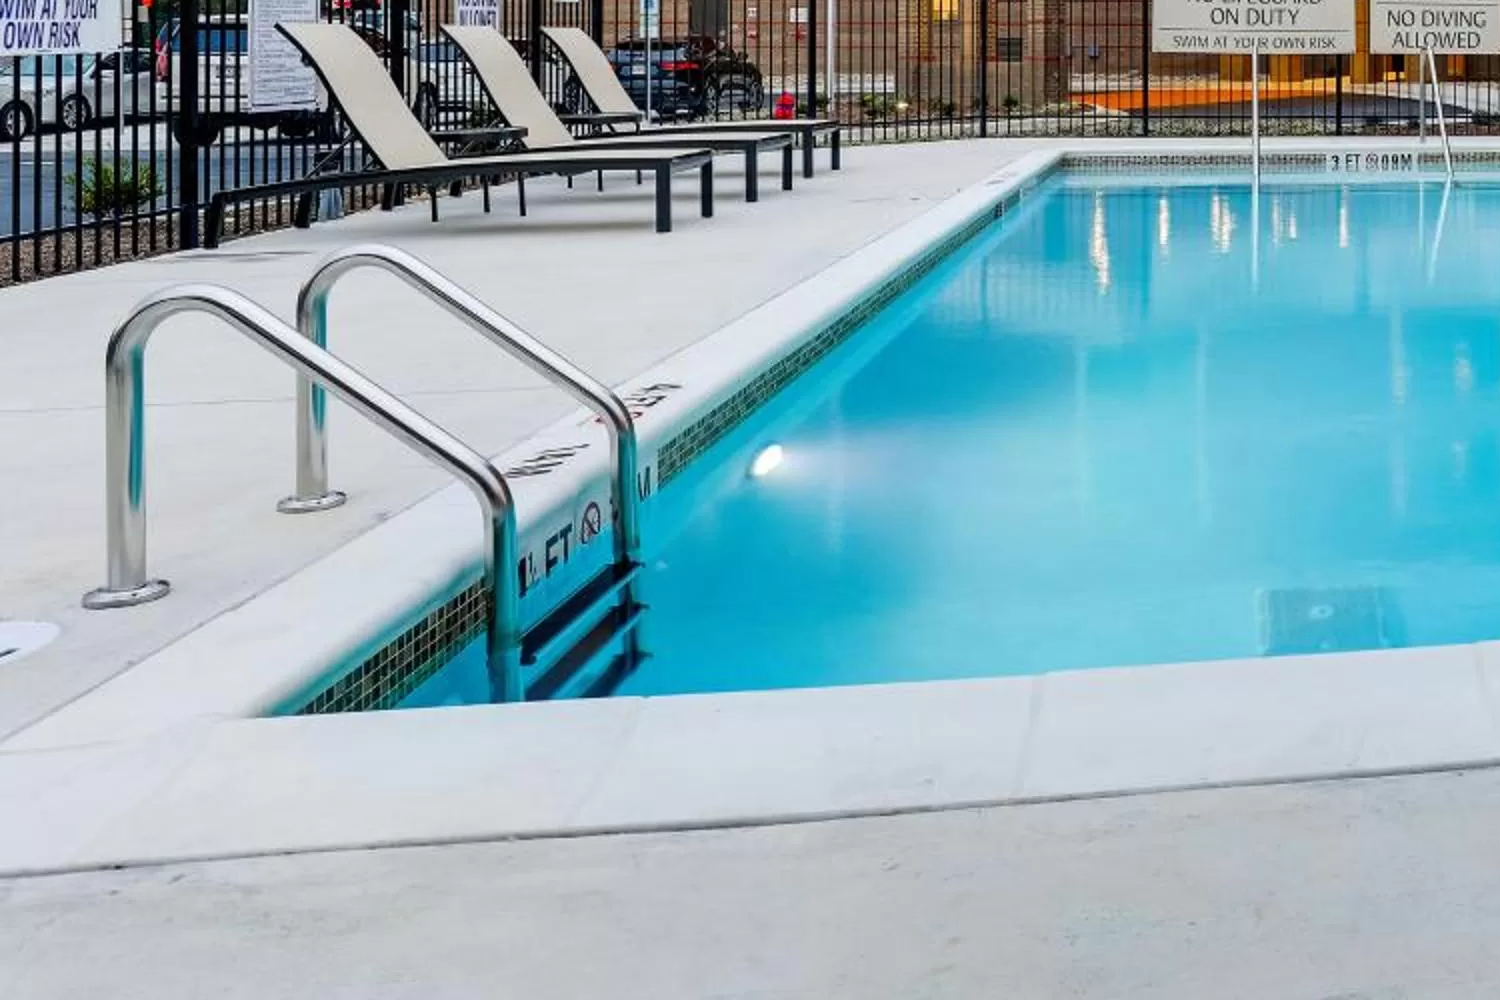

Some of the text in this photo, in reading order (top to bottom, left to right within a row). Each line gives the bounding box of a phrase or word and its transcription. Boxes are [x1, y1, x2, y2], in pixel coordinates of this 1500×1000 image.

[1210, 7, 1300, 26] ON DUTY
[1387, 10, 1487, 28] NO DIVING
[3, 21, 81, 49] OWN RISK
[1173, 35, 1336, 49] SWIM AT YOUR OWN RISK
[1391, 31, 1481, 49] ALLOWED
[1345, 153, 1361, 171] FT
[546, 524, 573, 578] FT
